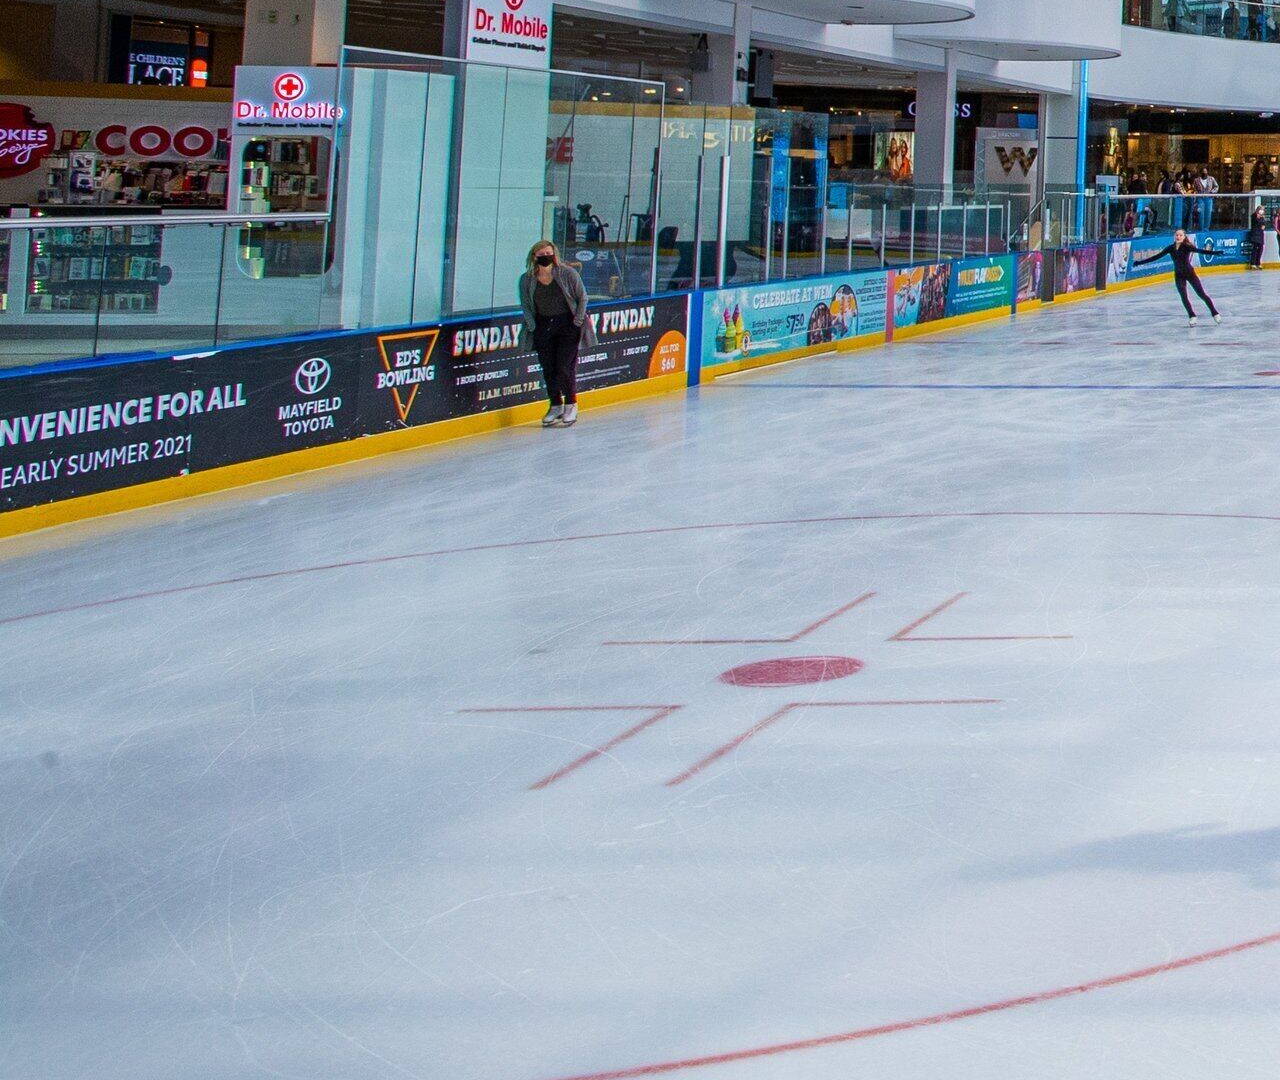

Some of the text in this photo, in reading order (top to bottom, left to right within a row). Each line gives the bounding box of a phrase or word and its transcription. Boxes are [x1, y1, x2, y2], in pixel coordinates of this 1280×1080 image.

[474, 7, 547, 39] Dr. Mobile
[136, 53, 186, 66] CHILDREN'S
[237, 101, 343, 119] Dr. Mobile
[95, 124, 231, 157] COO
[753, 284, 834, 309] CELEBRATE AT WEM
[452, 322, 523, 357] SUNDAY
[602, 305, 655, 334] FUNDAY
[395, 348, 421, 368] ED'S
[660, 344, 669, 355] ALL
[484, 369, 509, 381] BOWLING
[661, 357, 675, 372] $60
[376, 364, 436, 390] BOWLING
[156, 388, 205, 420] FOR
[207, 383, 247, 414] ALL
[502, 383, 522, 396] UNTIL
[278, 396, 342, 421] MAYFIELD
[283, 414, 334, 437] TOYOTA
[0, 433, 193, 490] EARLY SUMMER 2021
